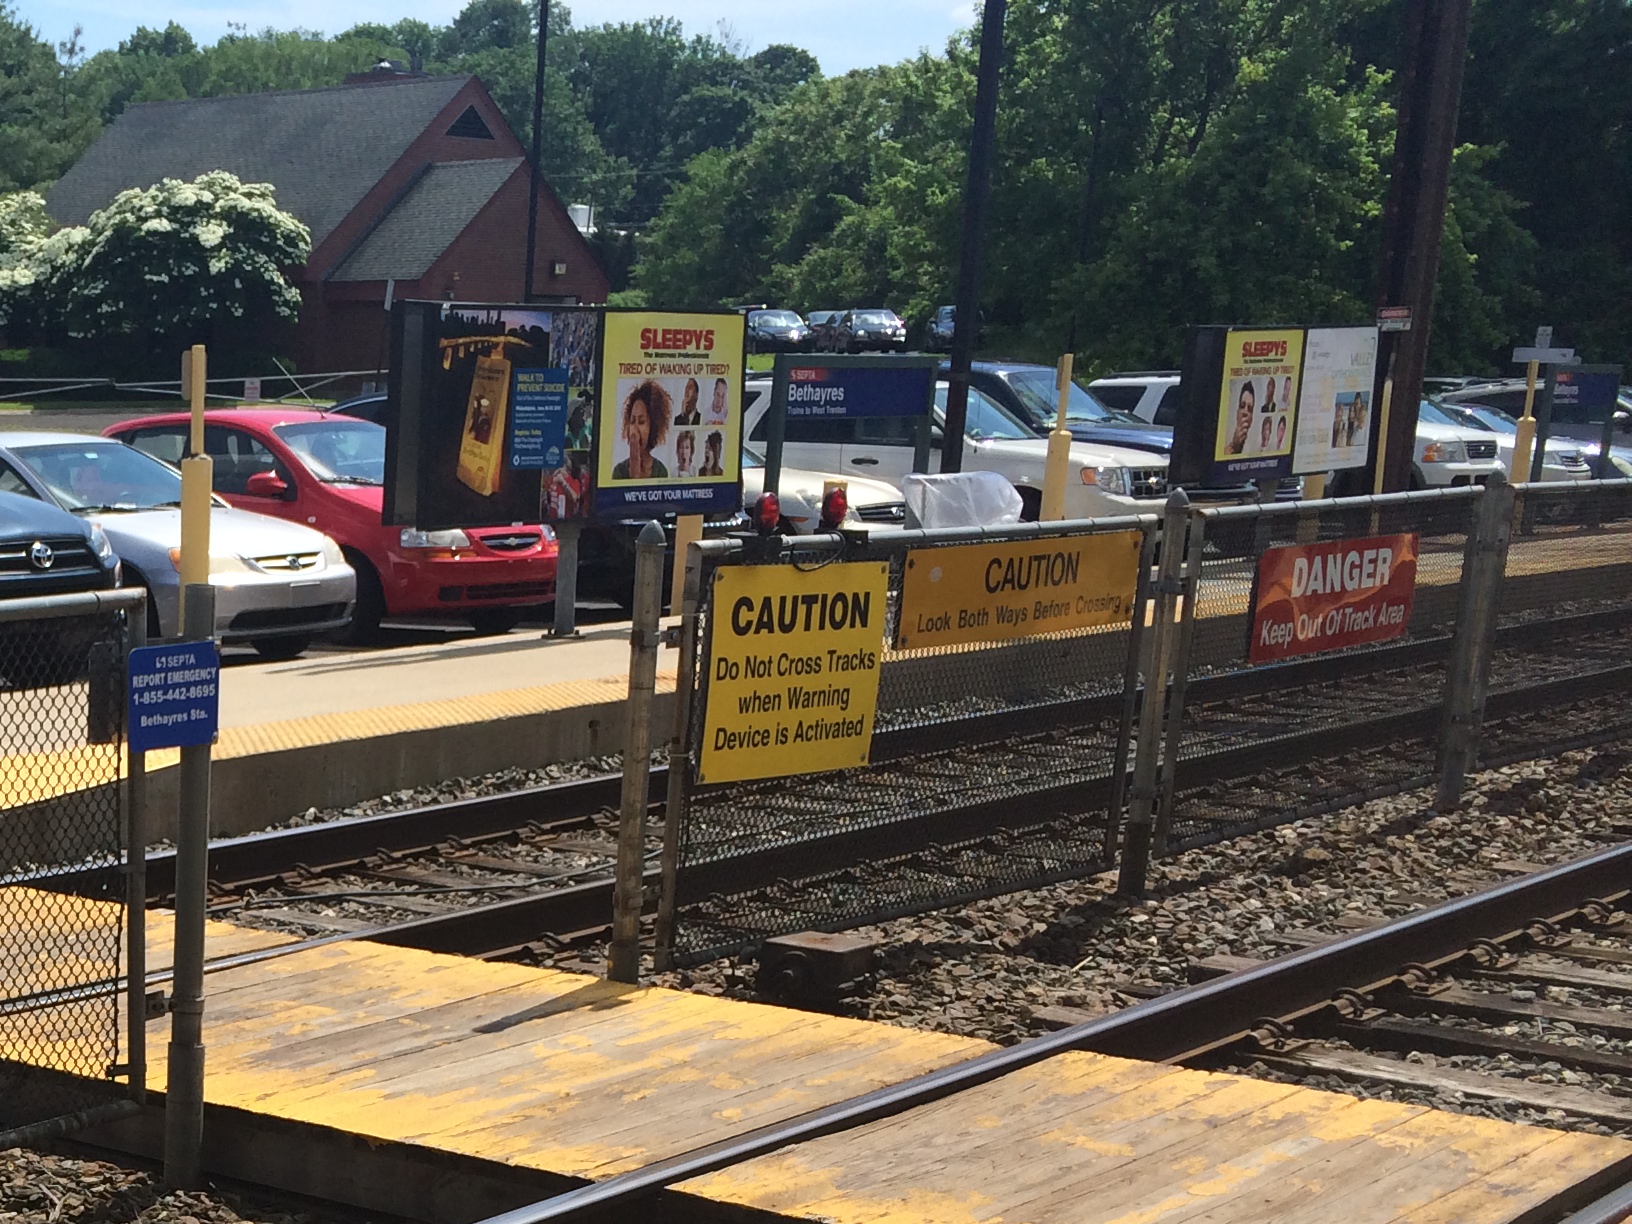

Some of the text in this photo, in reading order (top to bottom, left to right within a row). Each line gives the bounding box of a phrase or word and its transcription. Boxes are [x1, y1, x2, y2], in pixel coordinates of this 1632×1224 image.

[619, 363, 730, 375] TIRED OF WAKING UP TIRED?
[797, 370, 816, 379] SEPTA
[788, 384, 845, 405] Bethayres
[648, 490, 662, 500] GOT
[664, 489, 681, 500] YOUR
[682, 488, 714, 499] MATTRESS
[985, 551, 1080, 594] CAUTION
[1291, 548, 1393, 598] DANGER
[731, 591, 871, 636] CAUTION
[917, 593, 1122, 634] Look Both Ways Before Crossing
[1260, 602, 1405, 649] Keep Out Of Track Area
[167, 654, 196, 668] SEPTA
[716, 648, 876, 682] Do Not Cross Tracks
[133, 667, 217, 688] REPORT EMERGENCY
[133, 684, 216, 706] 1-855-442-8695
[738, 684, 850, 714] when Warning
[140, 708, 209, 727] Bethayres Sta.
[714, 714, 865, 752] Device is Activated
